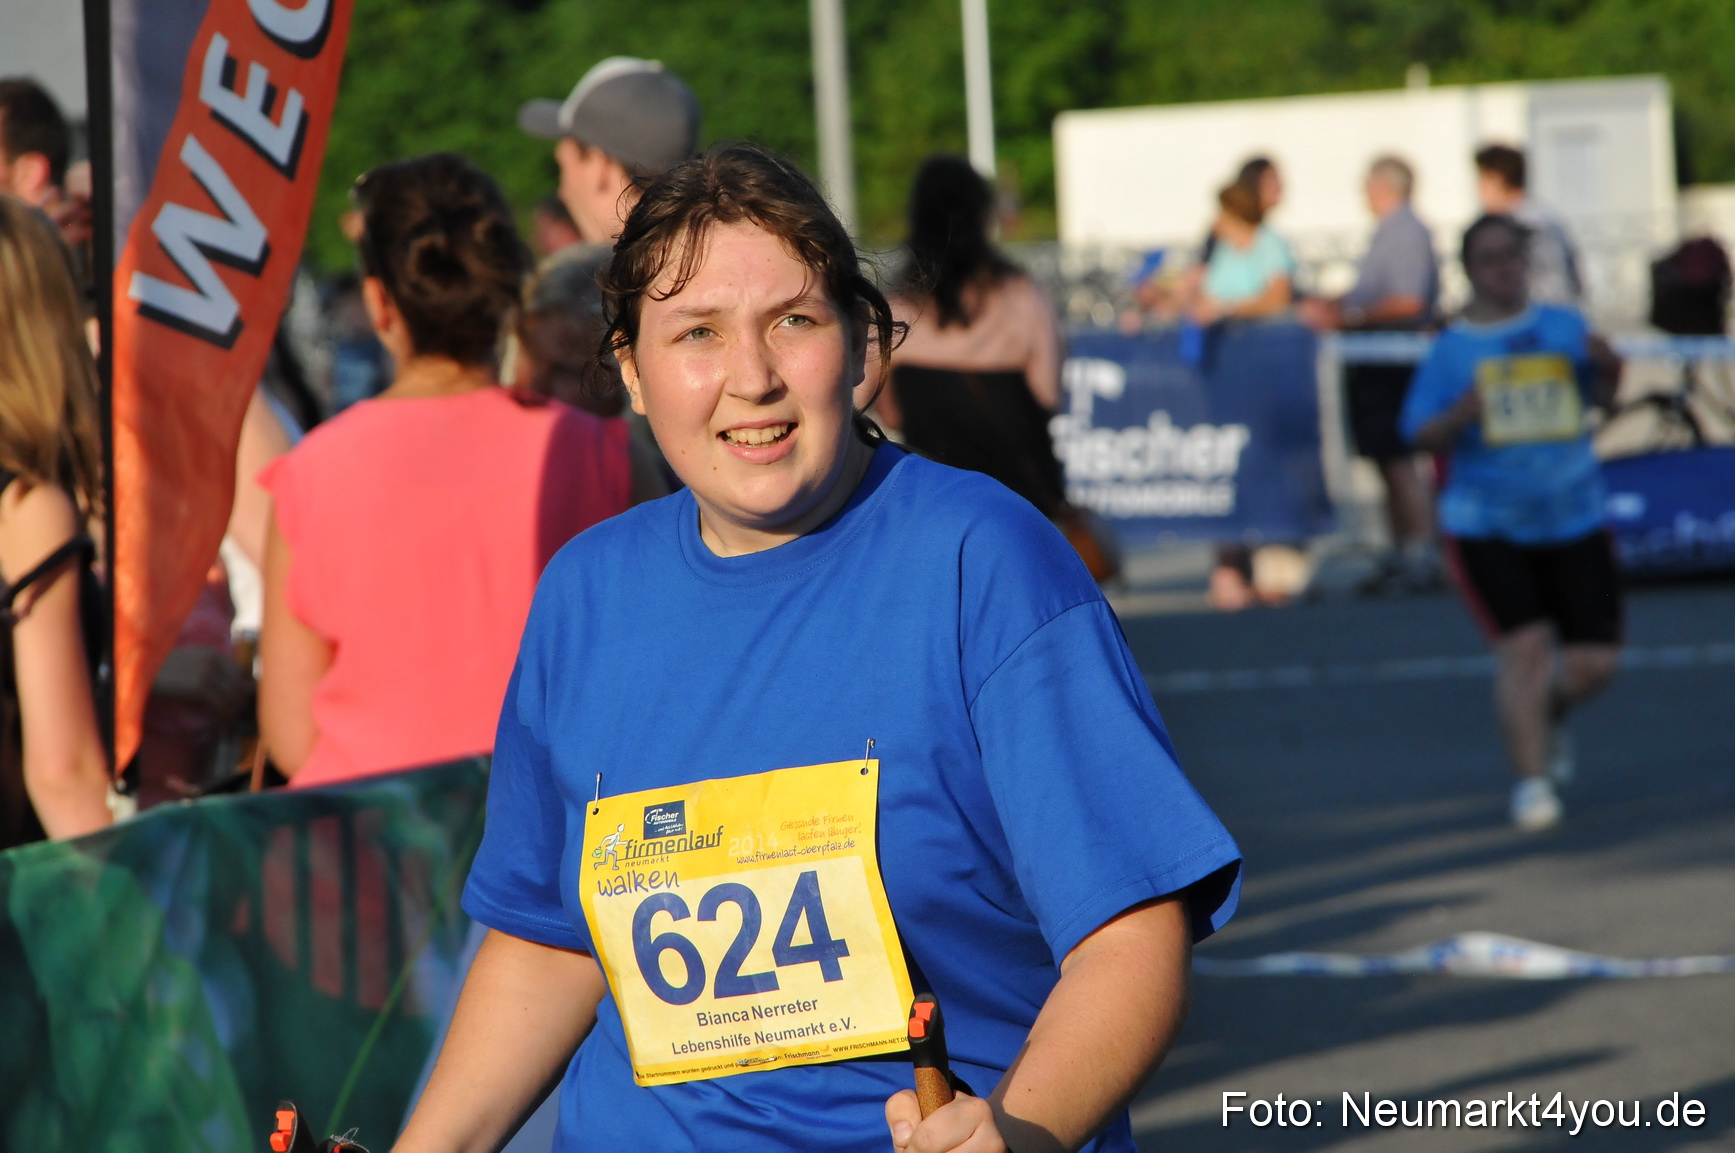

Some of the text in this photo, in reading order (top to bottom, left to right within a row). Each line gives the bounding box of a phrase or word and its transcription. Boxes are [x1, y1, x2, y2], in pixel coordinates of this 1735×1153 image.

[651, 812, 679, 822] Fischer
[780, 813, 854, 831] Gesunde Firmen
[625, 826, 723, 859] firmenlauf
[797, 822, 862, 841] laufen länger!
[728, 832, 779, 856] 2014
[736, 838, 856, 864] www.firmenlauf-oberpfalz.de
[625, 855, 670, 868] neumarkt
[598, 870, 680, 897] walken
[632, 870, 850, 1006] 624
[696, 999, 818, 1027] Bianca Nerreter
[671, 1017, 857, 1055] Lebenshilfe Neumarkt e.V.
[784, 1050, 820, 1060] Frischmann
[646, 1069, 681, 1079] Startnummern
[681, 1066, 701, 1075] wurden
[701, 1063, 723, 1073] gedruckt
[724, 1061, 735, 1070] und
